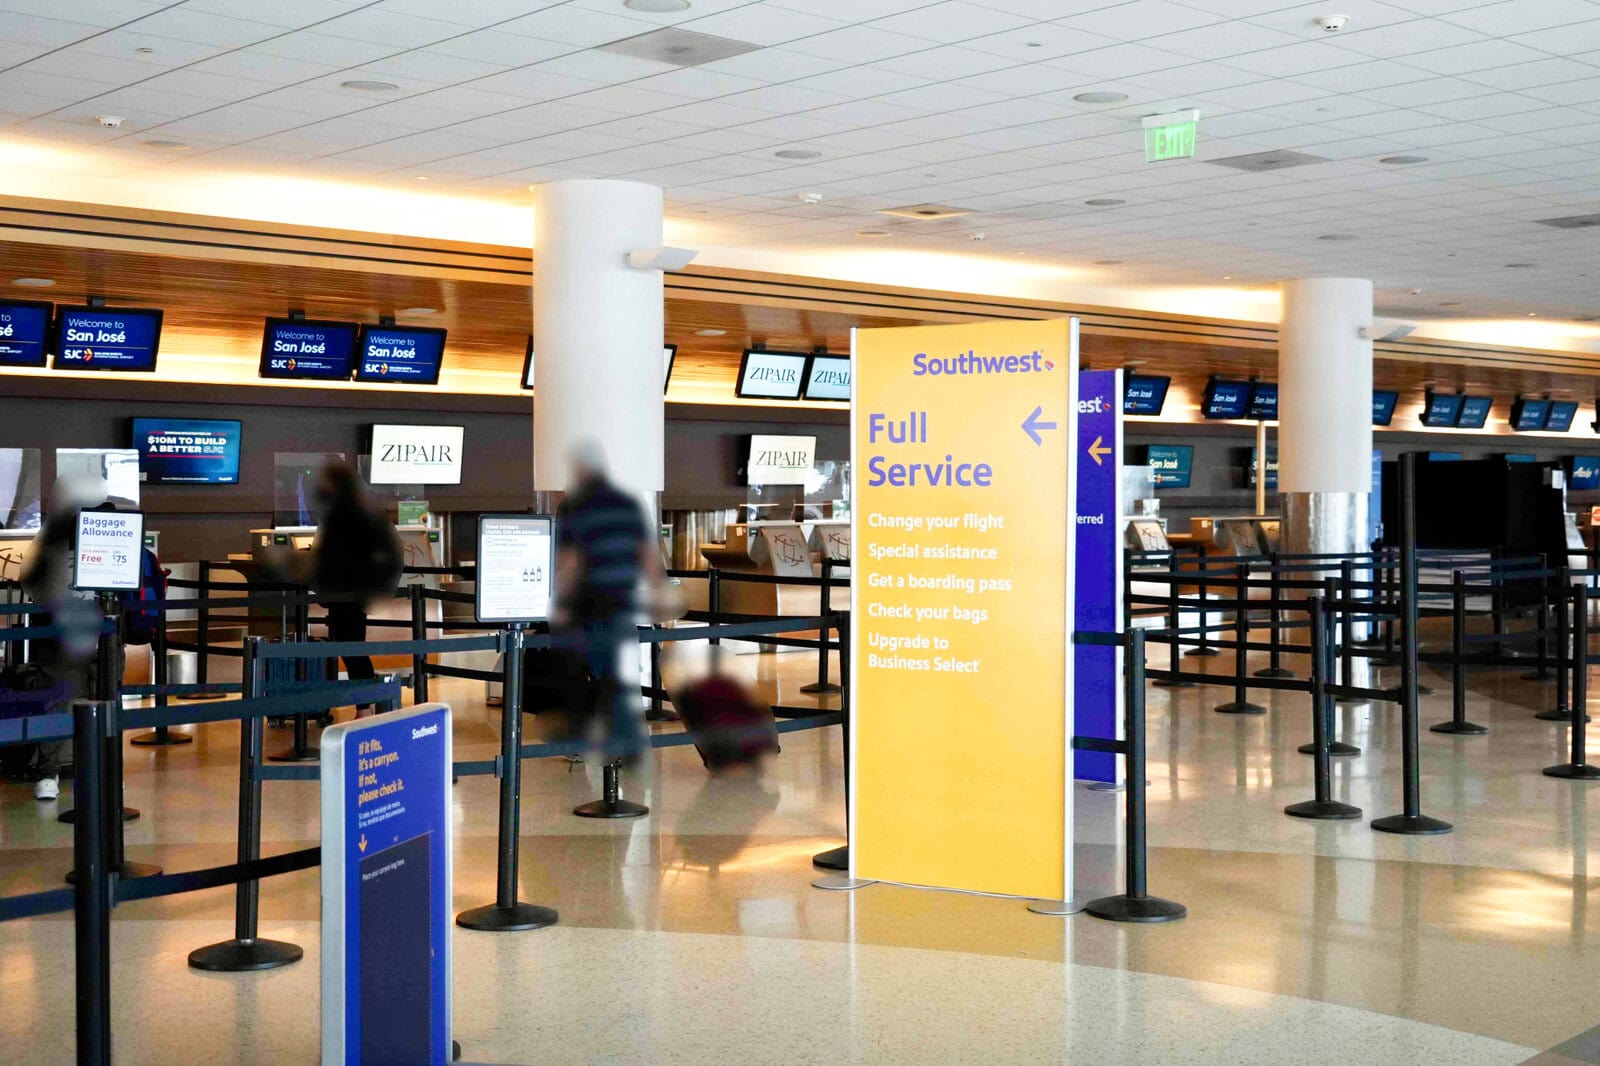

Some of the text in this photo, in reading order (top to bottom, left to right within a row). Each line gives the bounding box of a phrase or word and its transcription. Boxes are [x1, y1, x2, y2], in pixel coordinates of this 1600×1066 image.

[1155, 125, 1187, 160] EXIT
[0, 324, 13, 336] sé
[68, 318, 124, 329] Welcome to
[66, 329, 126, 343] San José
[276, 330, 325, 341] Welcome to
[370, 336, 415, 346] Welcome to
[64, 349, 82, 359] SJC
[274, 340, 326, 354] San José
[367, 345, 416, 359] San José
[271, 359, 287, 369] SJC
[364, 363, 380, 373] SJC
[913, 350, 1042, 376] Southwest
[750, 367, 796, 382] ZIPAIR
[814, 371, 850, 384] ZIPAI
[869, 411, 927, 444] Full
[147, 435, 227, 446] $10M TO BUILD
[149, 445, 158, 453] A
[160, 445, 202, 453] BETTER
[381, 444, 453, 462] ZIPAIR
[756, 450, 807, 466] ZIPAIR
[868, 454, 993, 487] Service
[83, 516, 126, 528] Baggage
[868, 513, 1004, 532] Change your flight
[1075, 513, 1104, 525] ferred
[82, 527, 134, 537] Allowance
[81, 553, 128, 563] Free $75
[869, 543, 997, 560] Special assistance
[869, 573, 1012, 593] Get a boarding pass
[868, 602, 988, 624] Check your bags
[868, 632, 949, 651] Upgrade to
[868, 654, 980, 673] Business Select
[412, 723, 438, 740] Southwest
[359, 739, 382, 755] If it fits,
[359, 752, 399, 771] it's a carryon.
[359, 772, 378, 788] If not,
[359, 789, 379, 807] please
[379, 780, 397, 797] check
